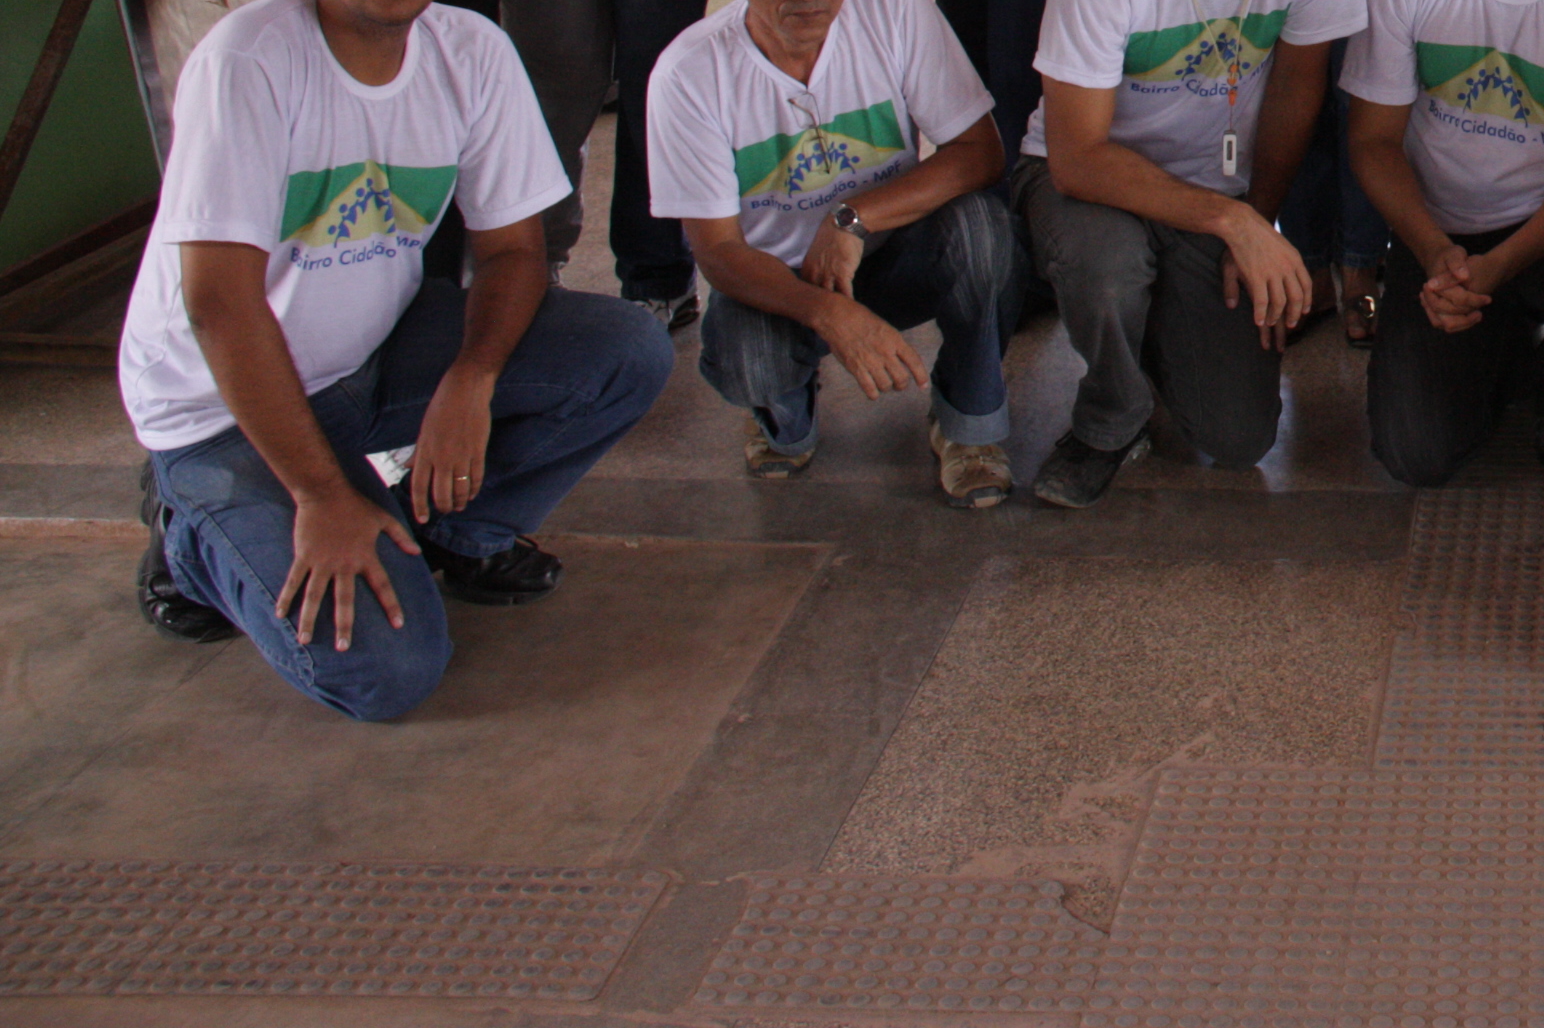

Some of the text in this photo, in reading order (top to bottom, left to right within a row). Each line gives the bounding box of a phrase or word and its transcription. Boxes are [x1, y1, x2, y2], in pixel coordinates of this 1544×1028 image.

[1130, 83, 1180, 94] Bairro
[1428, 99, 1461, 128] Bairro
[1461, 119, 1526, 145] Cidadão
[751, 195, 792, 212] Bairro
[797, 179, 857, 211] Cidadão
[873, 160, 902, 184] MPF
[339, 240, 396, 265] Cidadão
[396, 236, 422, 250] MP
